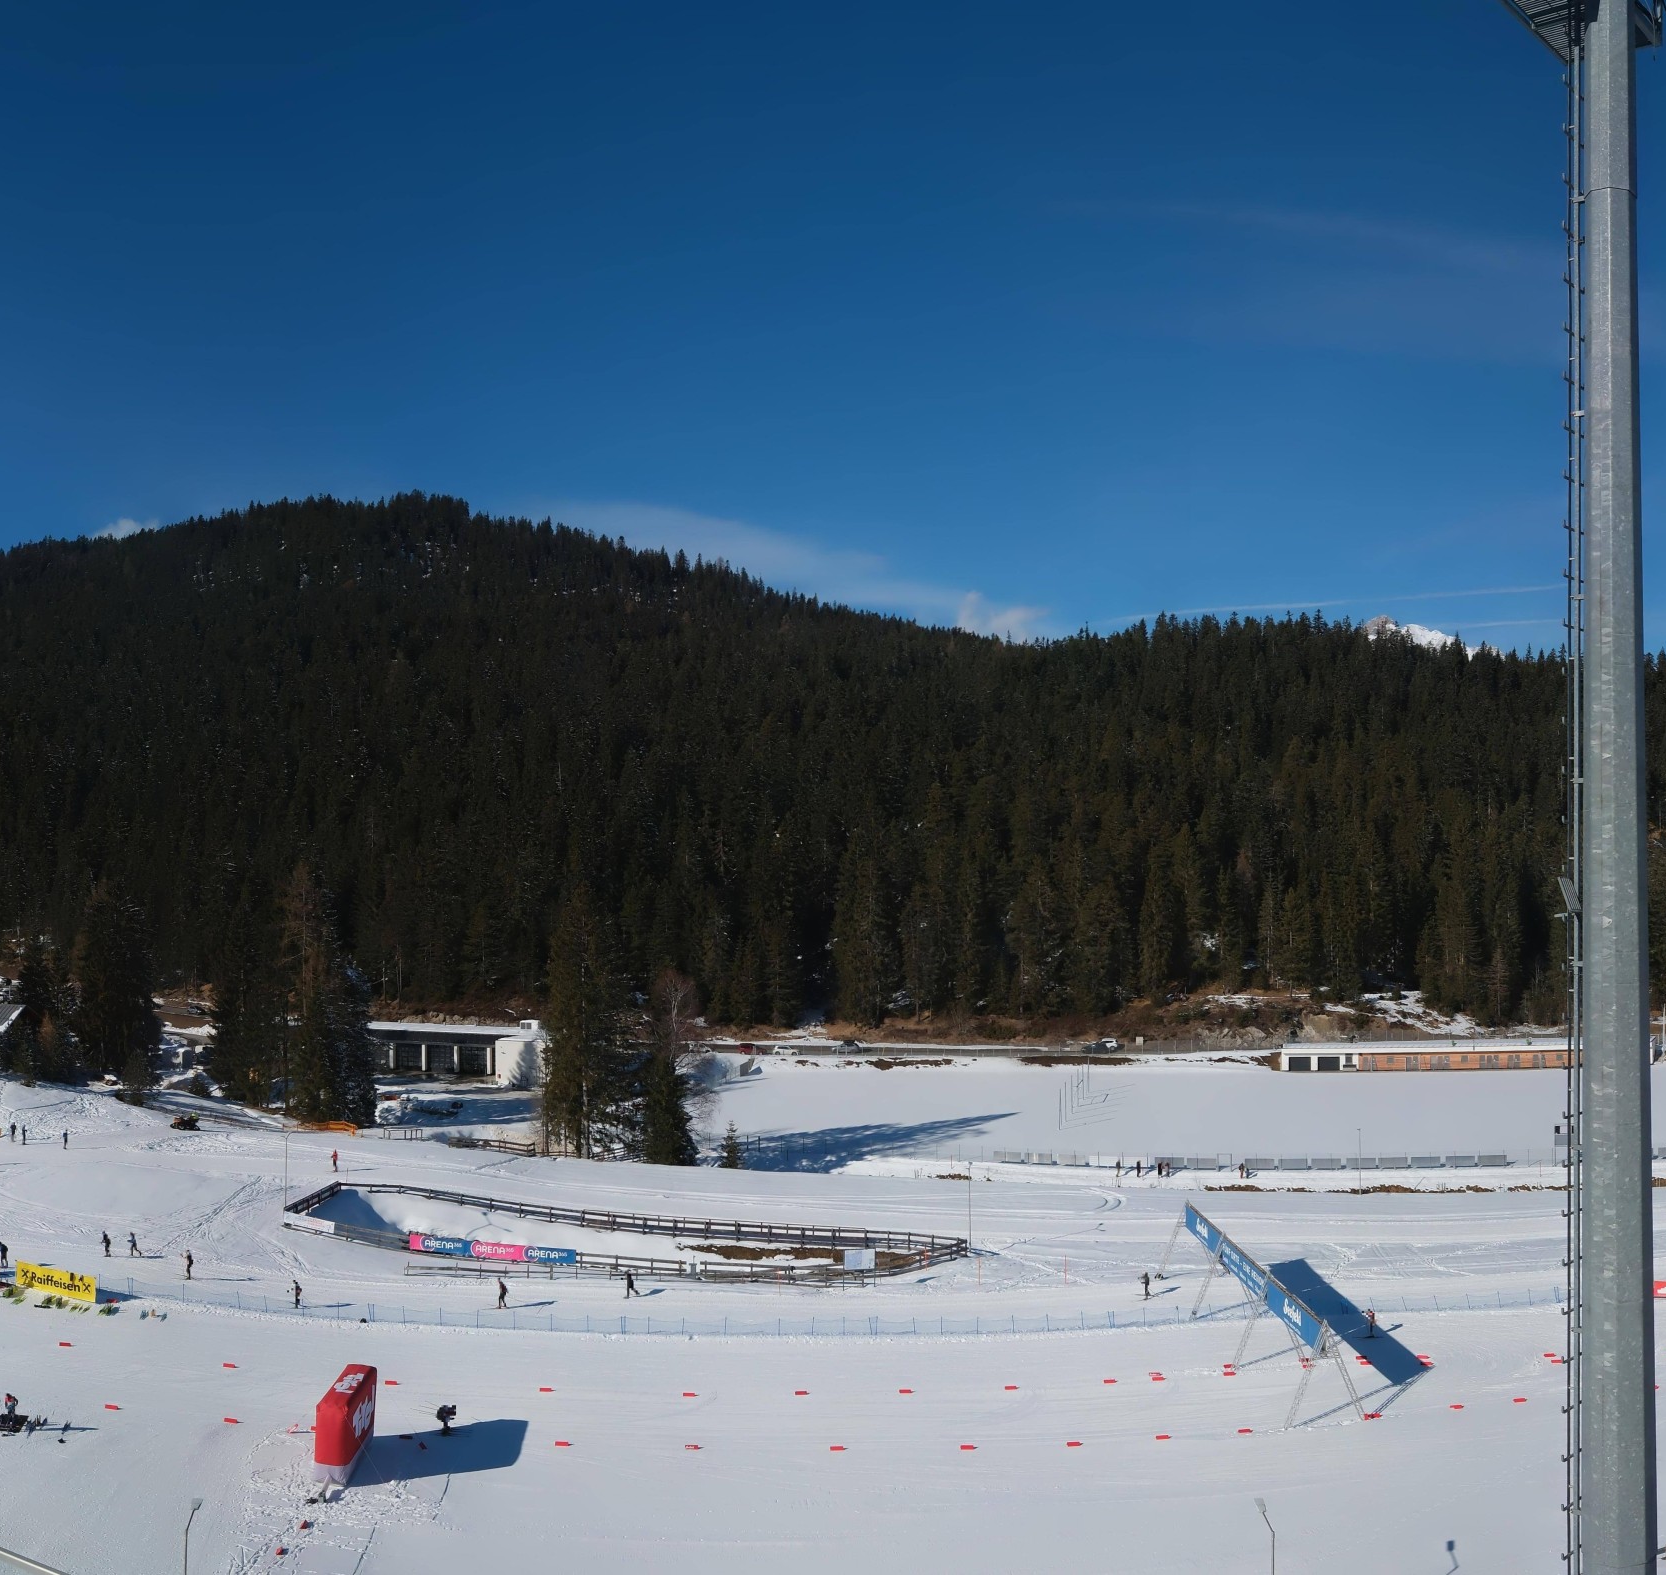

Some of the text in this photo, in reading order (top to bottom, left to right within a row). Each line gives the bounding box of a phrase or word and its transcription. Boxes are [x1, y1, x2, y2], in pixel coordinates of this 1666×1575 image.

[424, 1239, 454, 1249] ARENA
[475, 1245, 506, 1254] ARENA
[527, 1249, 559, 1259] ARENA
[31, 1272, 80, 1292] Raiffeisen
